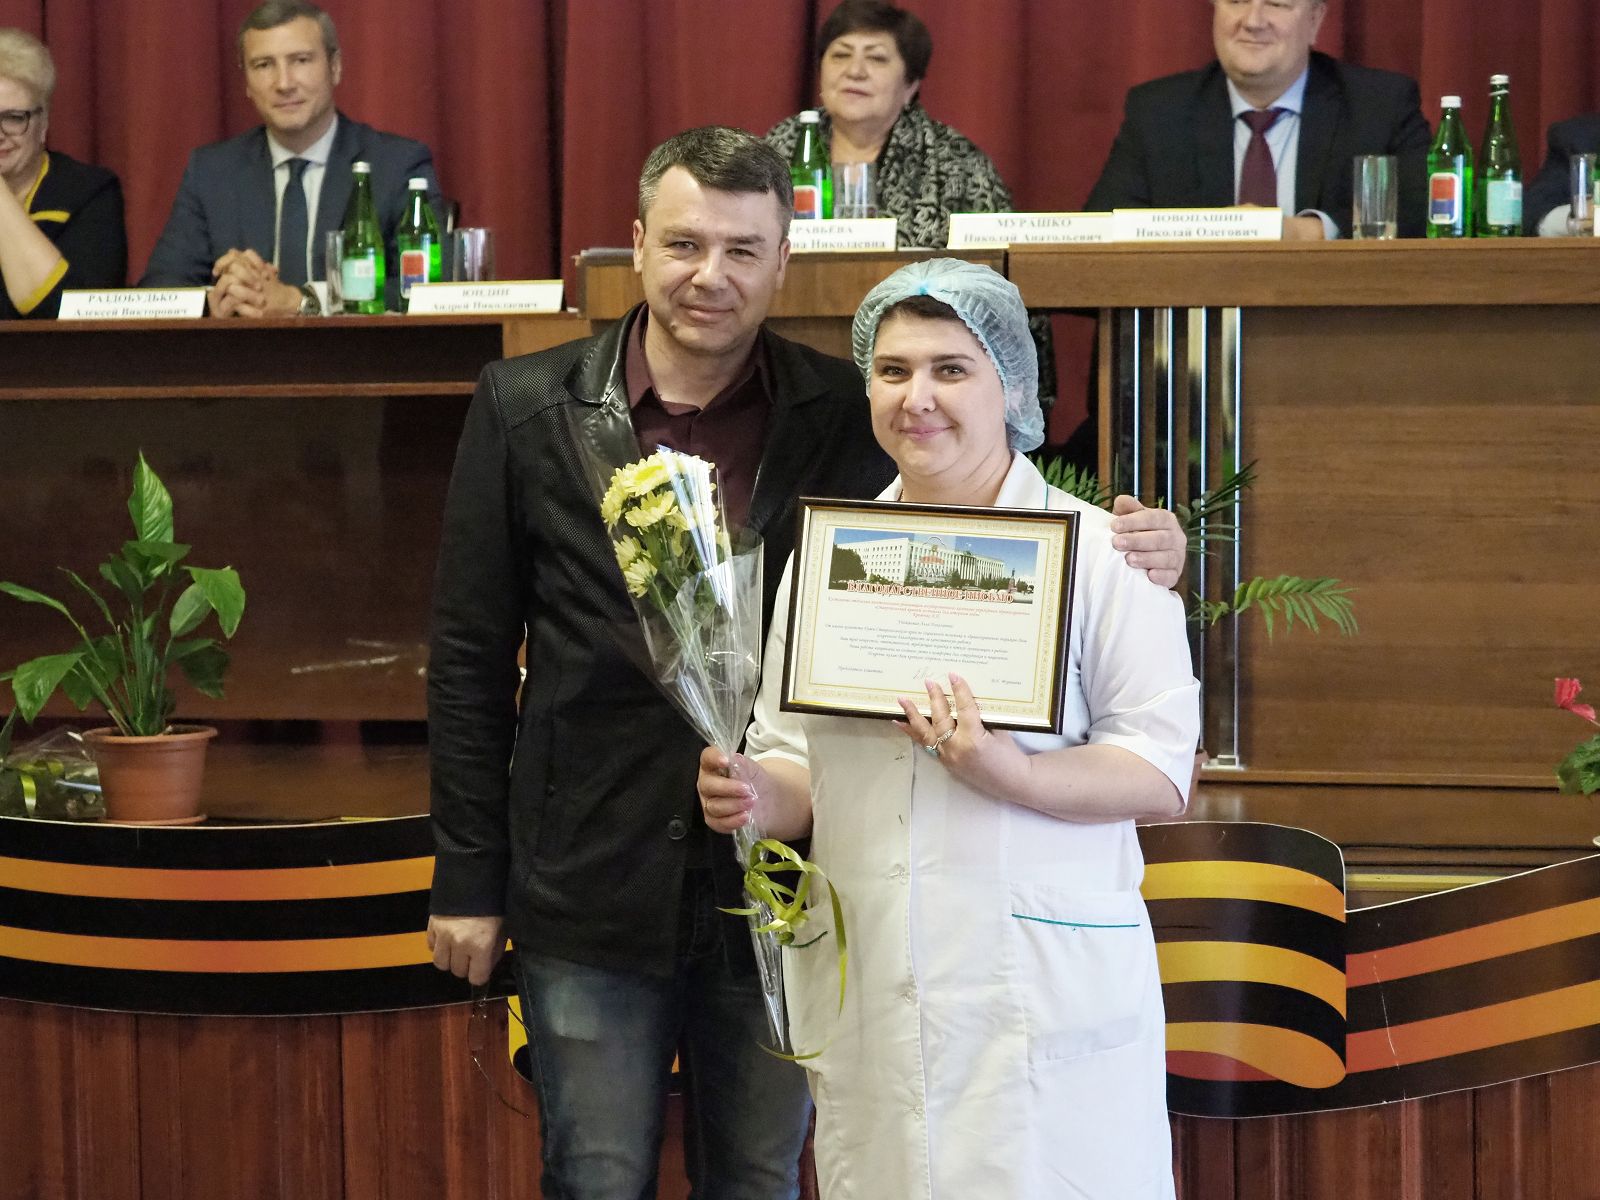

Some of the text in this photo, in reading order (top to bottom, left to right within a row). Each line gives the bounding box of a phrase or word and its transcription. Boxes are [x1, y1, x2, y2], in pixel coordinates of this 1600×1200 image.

[998, 218, 1072, 228] МУРАШКО
[1136, 227, 1258, 238] Николай Олегович
[964, 233, 1018, 243] Николай
[811, 240, 886, 249] Николаевна
[847, 581, 960, 600] БЛАГОДАРСТВЕННОЕ
